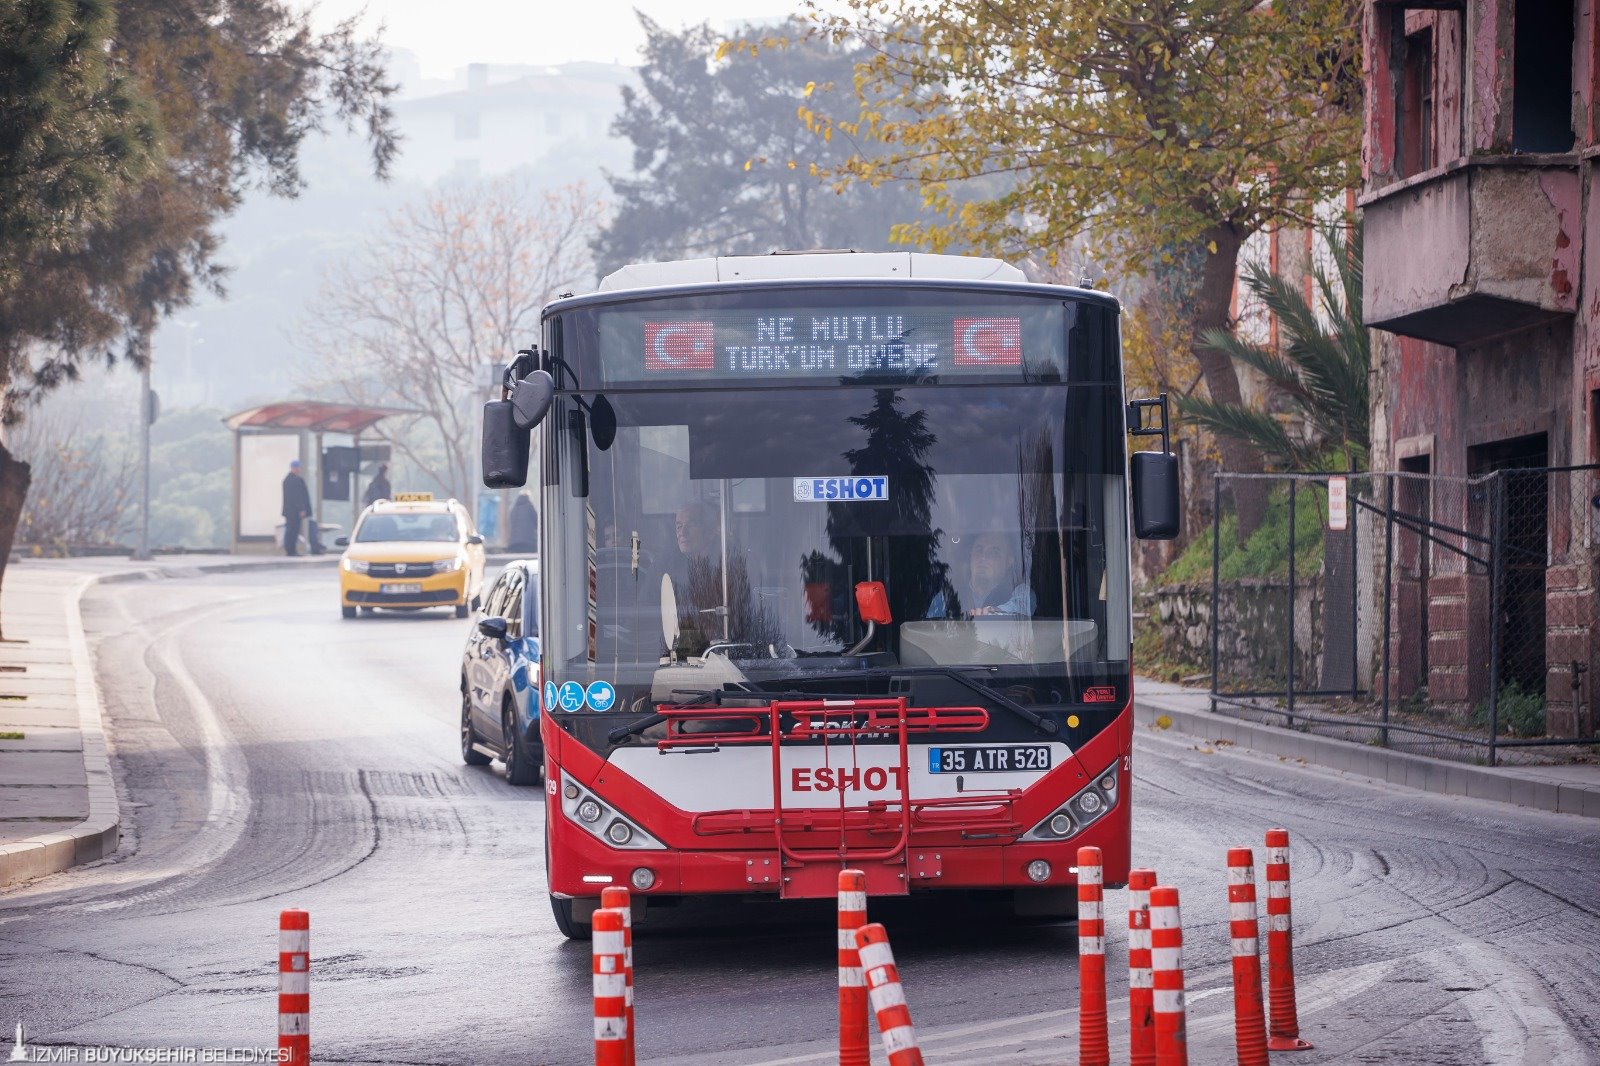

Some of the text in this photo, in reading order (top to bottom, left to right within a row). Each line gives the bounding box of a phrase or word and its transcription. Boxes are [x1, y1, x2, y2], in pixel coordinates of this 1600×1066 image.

[757, 316, 903, 342] NE MUTLU
[813, 478, 885, 499] ESHOT
[942, 750, 966, 771] 35
[973, 749, 1008, 770] ATR
[1014, 748, 1048, 769] 528
[791, 766, 910, 792] ESHOT
